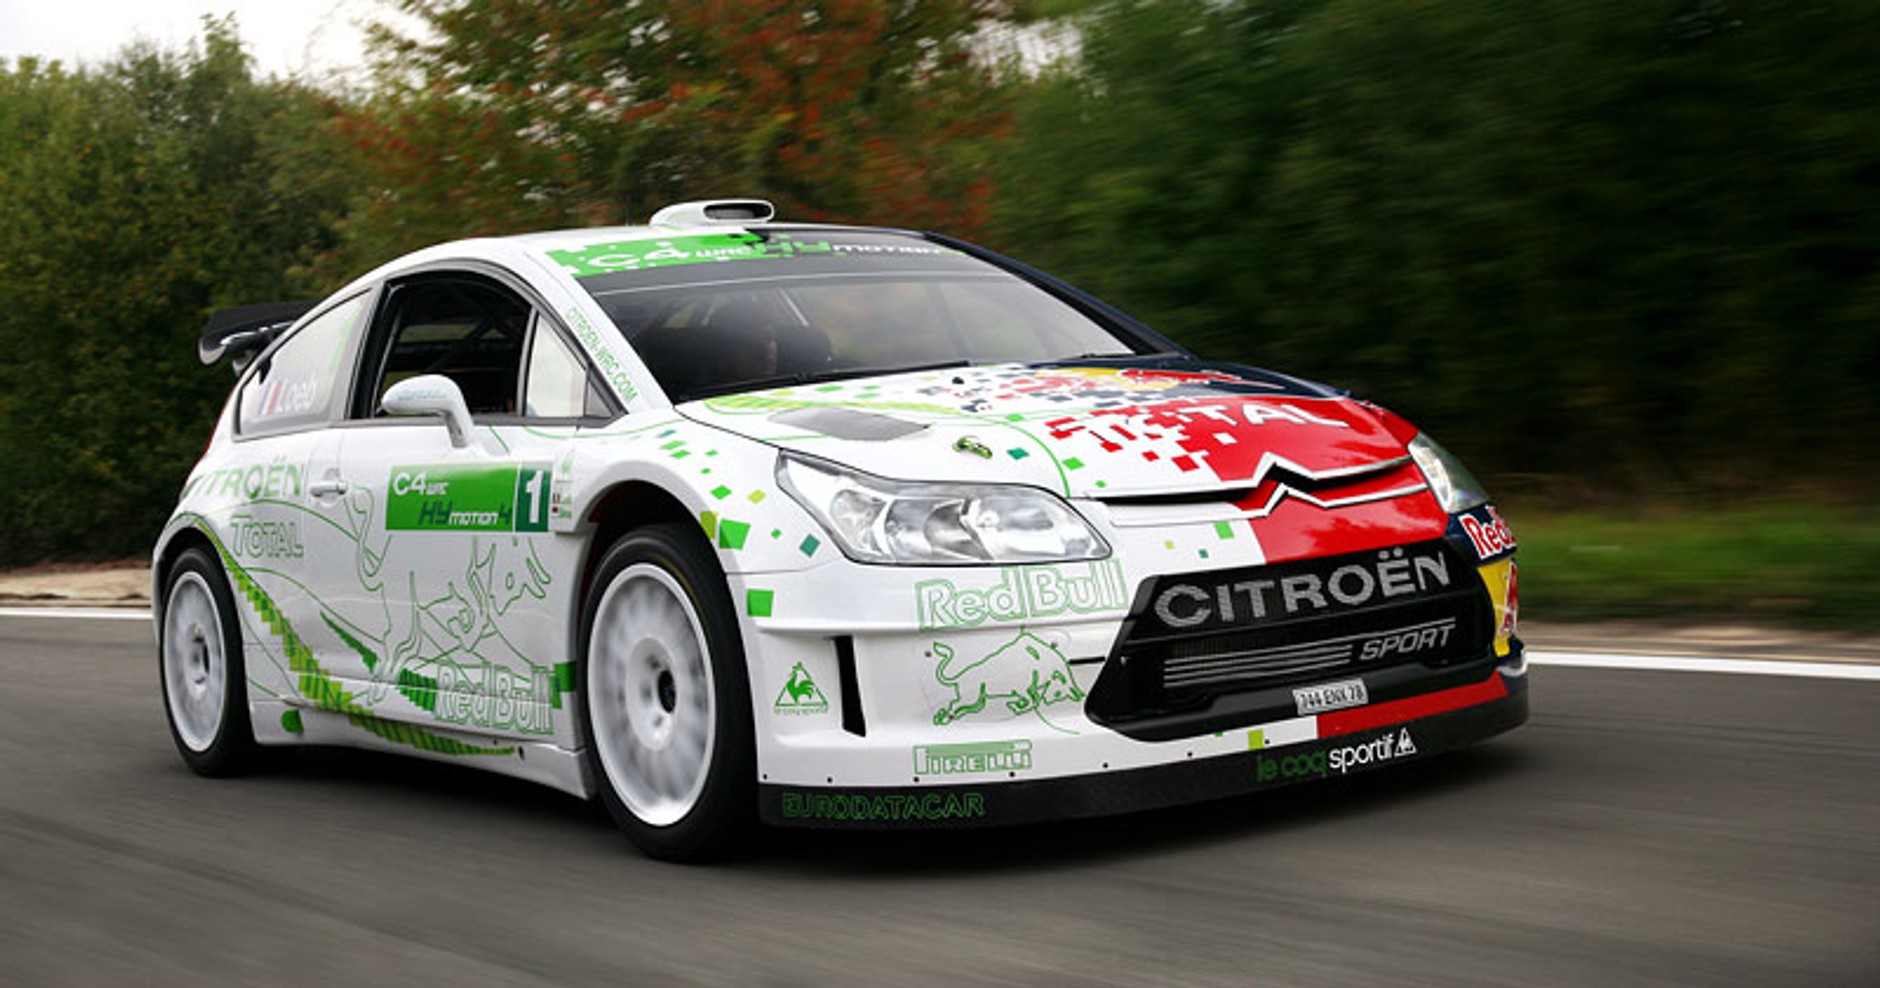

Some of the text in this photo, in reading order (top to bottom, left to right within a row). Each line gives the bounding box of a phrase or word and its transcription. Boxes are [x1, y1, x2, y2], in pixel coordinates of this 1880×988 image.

[392, 472, 427, 496] C4
[526, 470, 543, 524] 1
[229, 513, 304, 558] TOTAL
[1458, 504, 1517, 561] Red
[914, 557, 1131, 632] Red Bull
[1154, 547, 1451, 629] CITROËN
[1359, 621, 1456, 661] SPORT
[914, 740, 1033, 775] PIRELLI
[1256, 733, 1395, 782] le coq sportif
[782, 792, 985, 820] EURODATACAR
